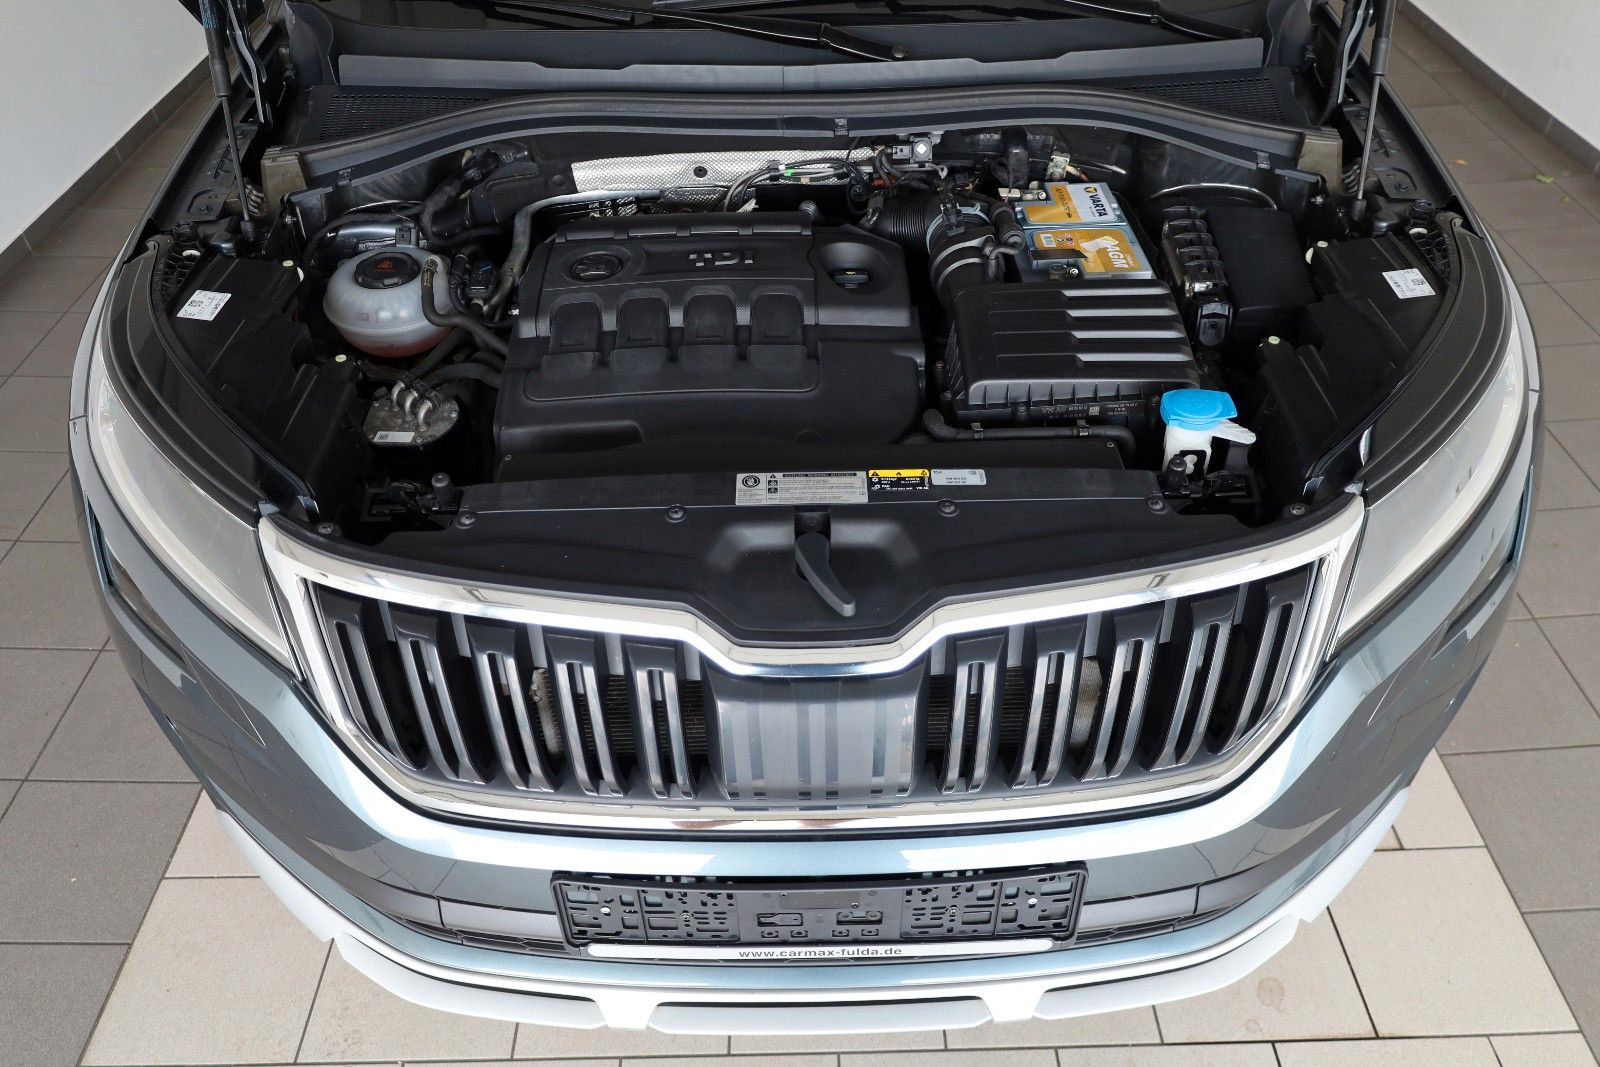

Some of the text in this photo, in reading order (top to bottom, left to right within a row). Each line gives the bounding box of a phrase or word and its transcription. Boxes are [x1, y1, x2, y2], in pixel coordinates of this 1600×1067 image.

[1089, 194, 1109, 217] VARTA
[1106, 244, 1130, 269] AGM
[738, 948, 902, 958] www.carmax-fulda.de
